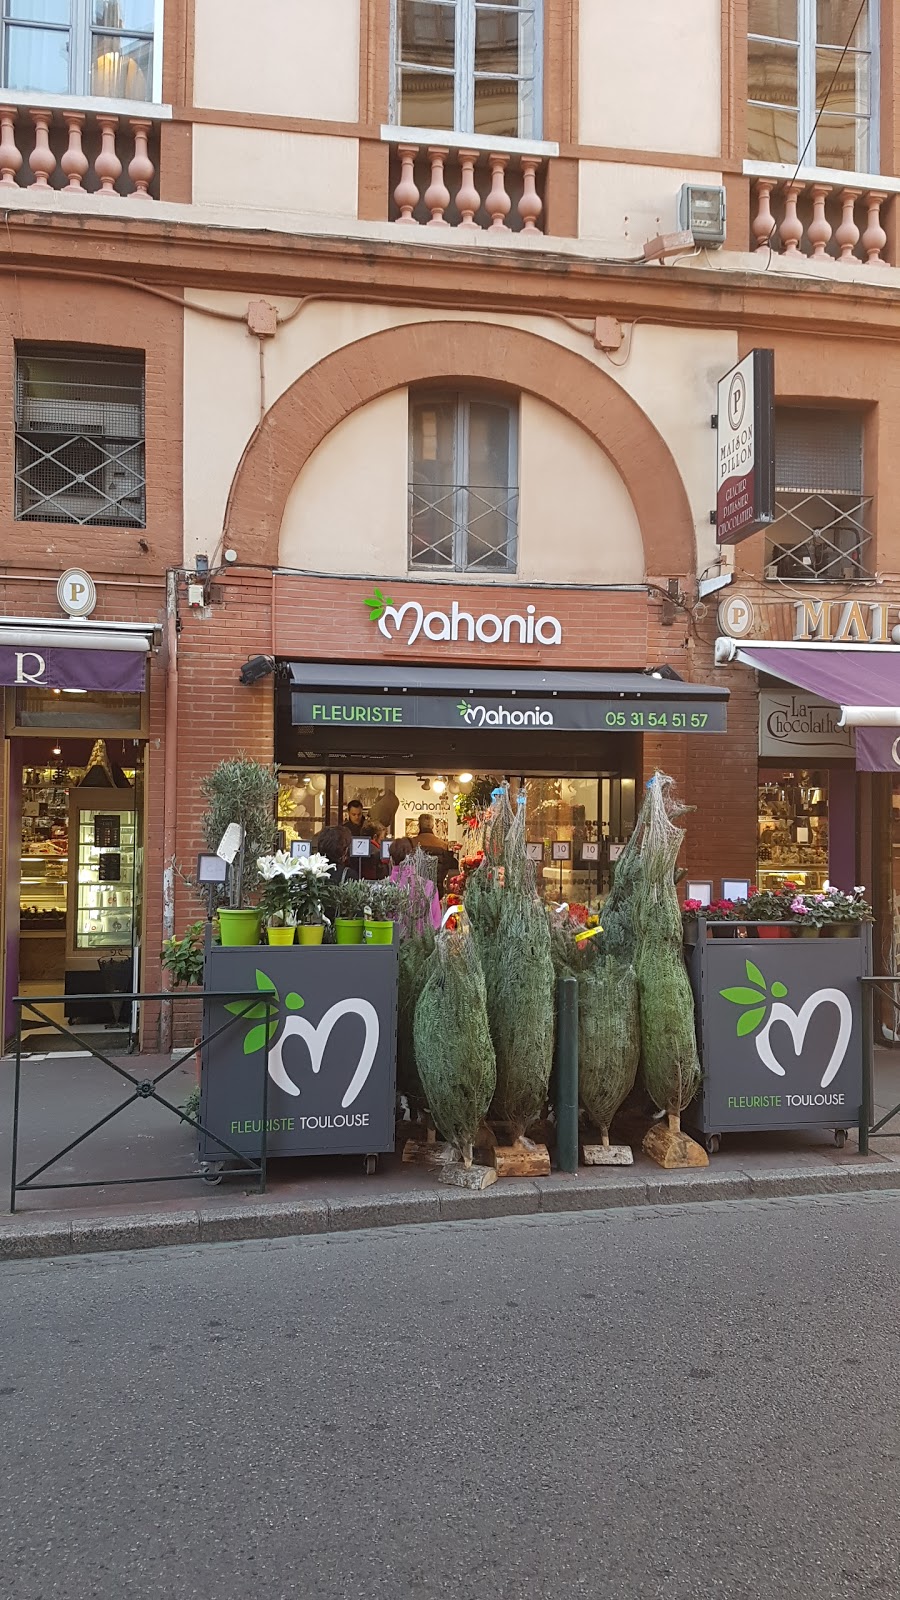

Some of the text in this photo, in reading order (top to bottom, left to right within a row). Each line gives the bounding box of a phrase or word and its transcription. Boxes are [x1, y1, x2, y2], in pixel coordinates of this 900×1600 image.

[733, 389, 741, 415] P
[720, 424, 753, 461] MAISON
[721, 443, 752, 478] PILLON
[69, 582, 85, 601] P
[377, 601, 562, 645] Mahonia
[731, 607, 746, 625] P
[794, 600, 900, 643] MAI
[312, 704, 403, 722] FLEURISTE
[463, 706, 553, 726] Mahonia
[791, 695, 807, 717] La
[605, 712, 708, 727] 05 31 54 51 57
[557, 845, 567, 853] 10
[728, 1093, 845, 1108] FLEURISTE TOULOUSE
[231, 1113, 370, 1134] FLEURISTE TOULOUSE
